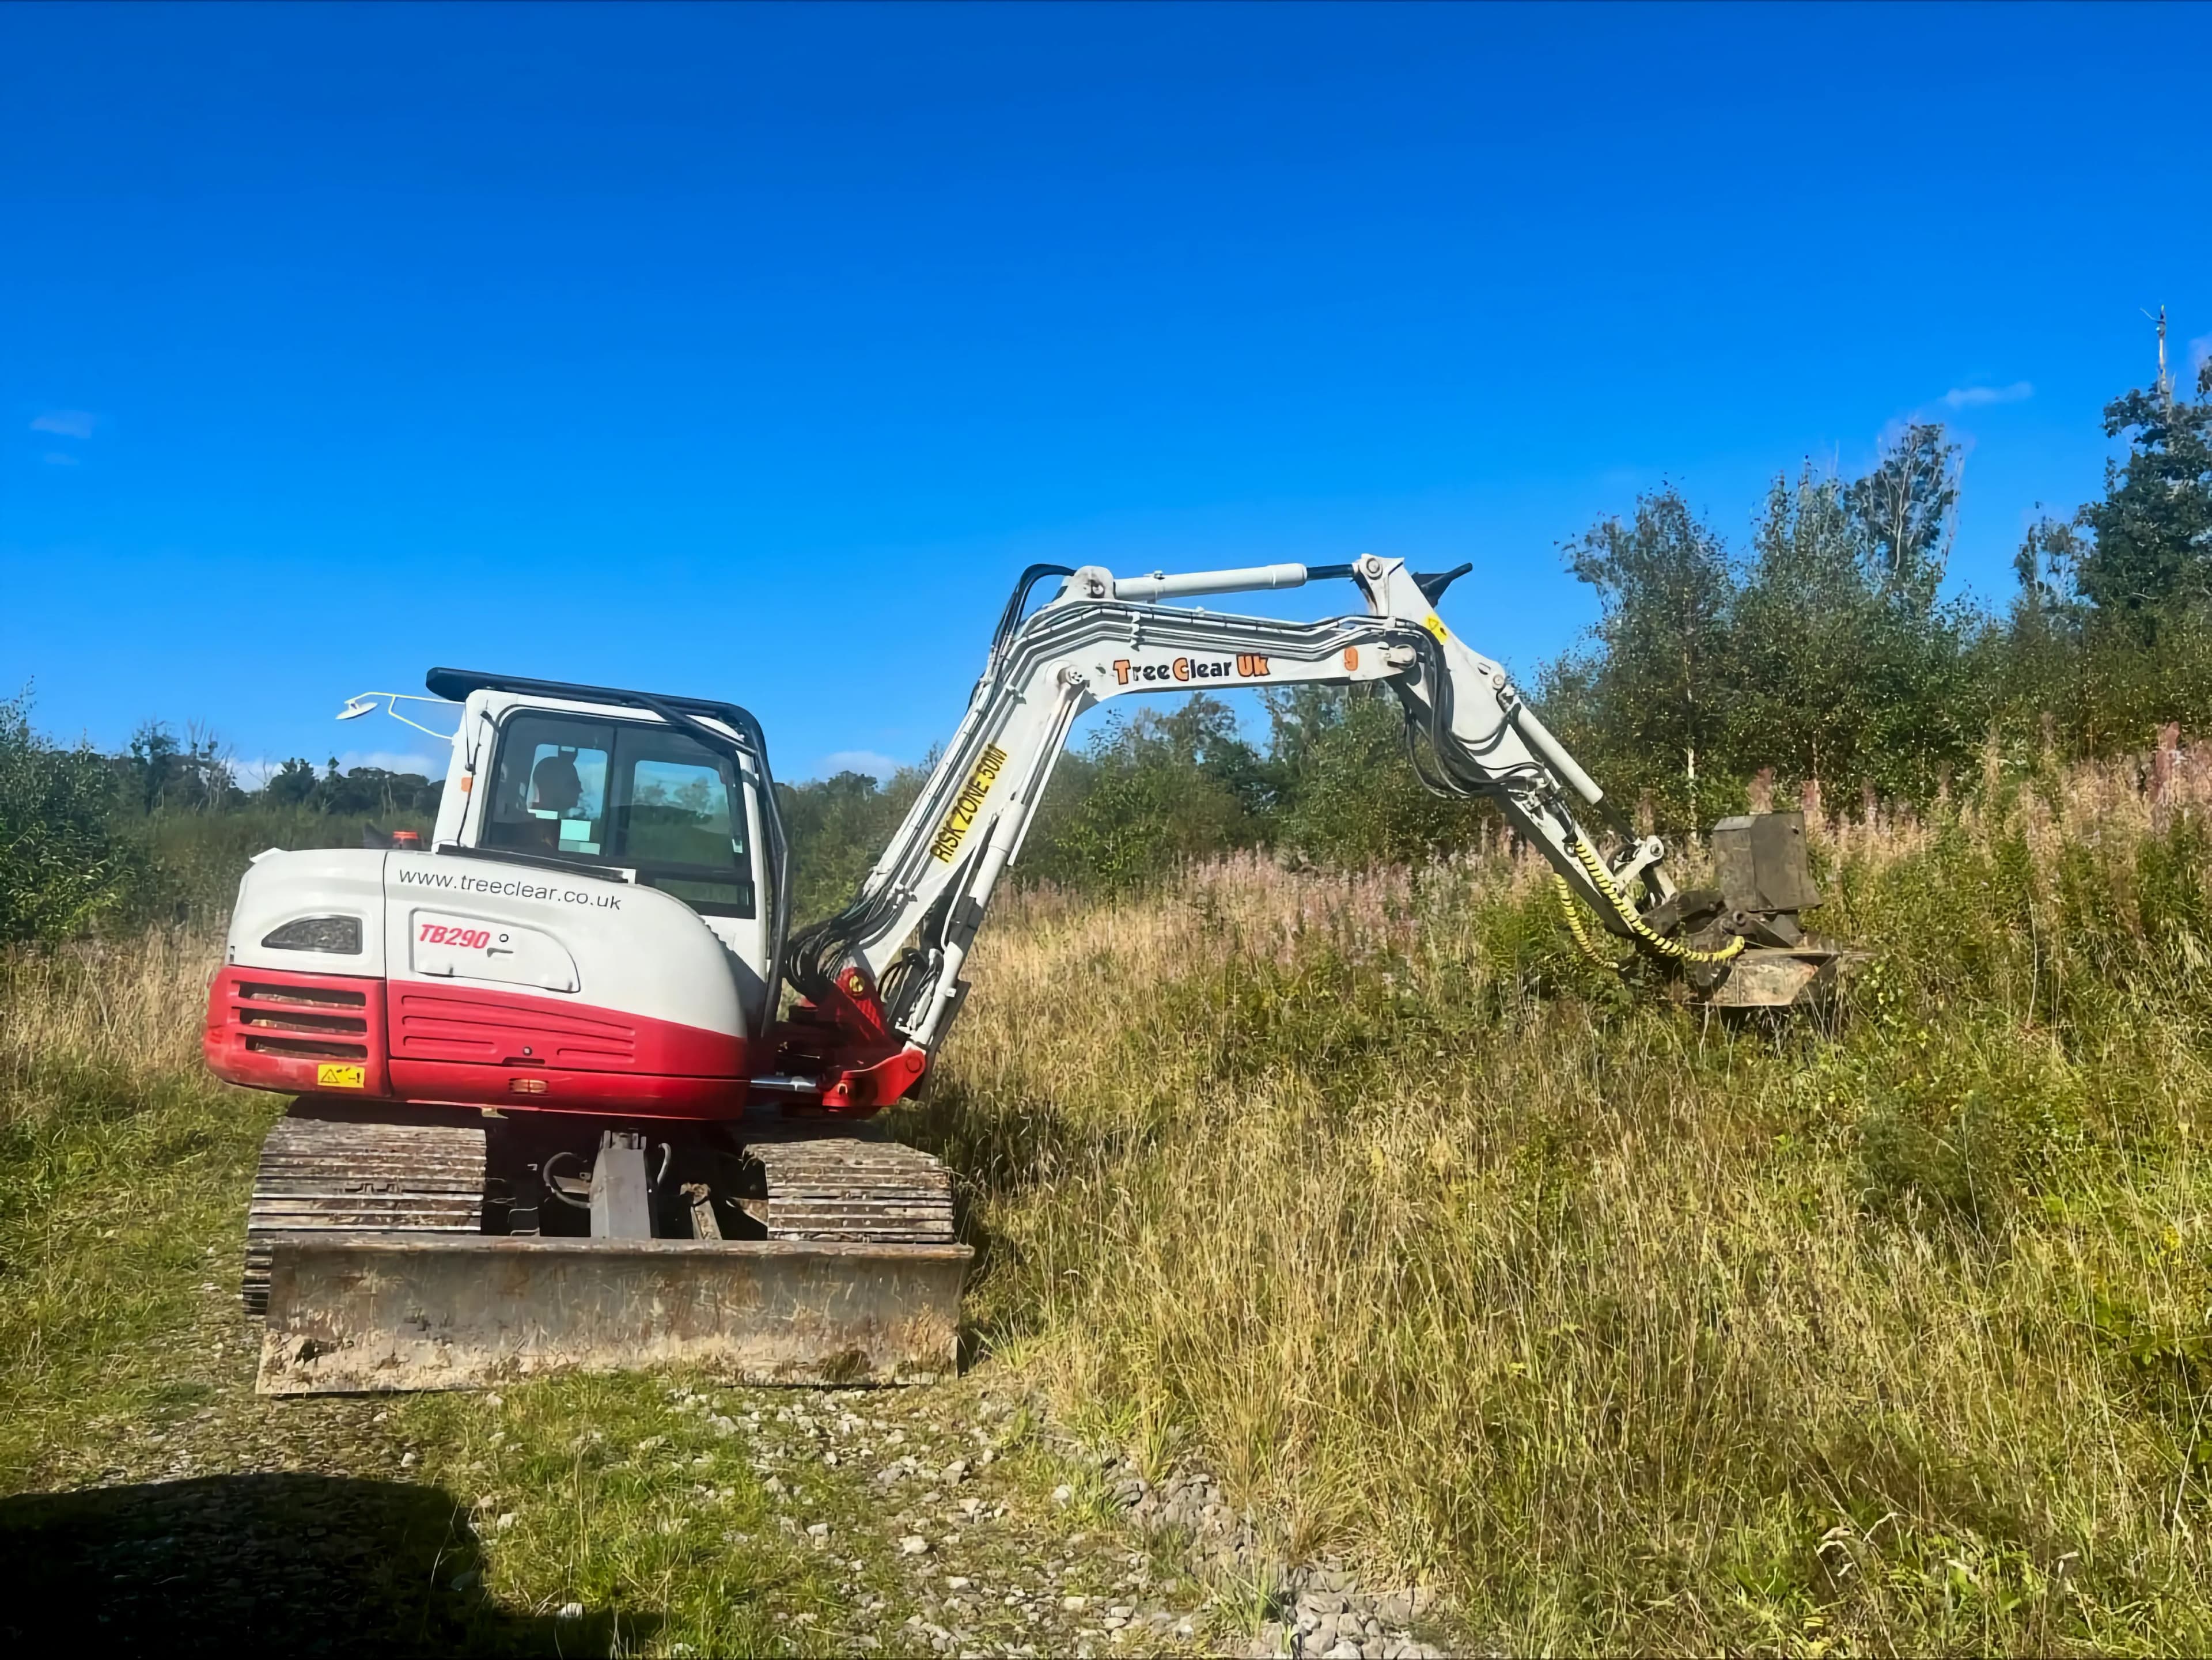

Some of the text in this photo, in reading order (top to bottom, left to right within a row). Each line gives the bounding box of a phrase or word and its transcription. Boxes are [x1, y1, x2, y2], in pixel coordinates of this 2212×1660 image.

[930, 744, 1007, 863] RISK ZONE 50M
[399, 869, 622, 910] www.treeclear.co.uk
[419, 924, 490, 949] TB290
